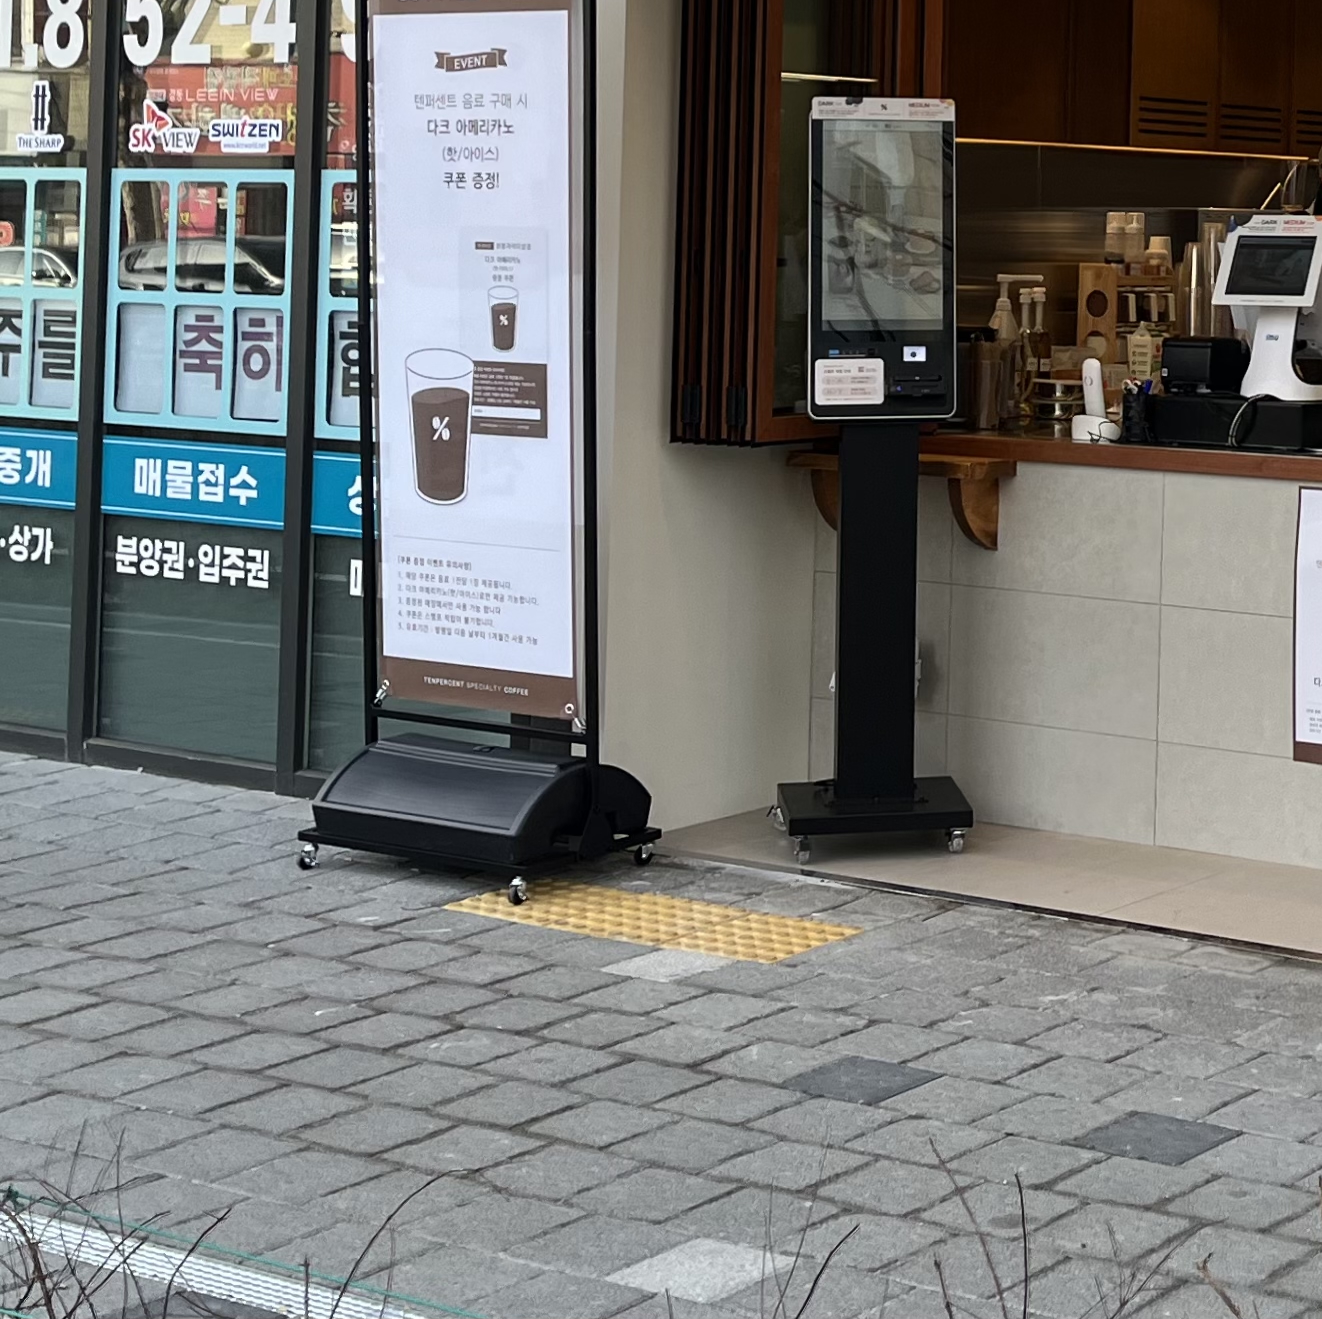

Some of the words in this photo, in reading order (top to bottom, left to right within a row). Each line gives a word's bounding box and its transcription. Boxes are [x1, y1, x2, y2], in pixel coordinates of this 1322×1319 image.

[453, 54, 488, 70] EVENT
[414, 93, 457, 110] 텐퍼센트
[461, 93, 485, 110] 음료
[489, 92, 512, 109] 구매
[517, 92, 528, 108] 시
[426, 119, 450, 136] 다크
[456, 118, 515, 136] 아메리카노
[131, 127, 151, 149] SK
[162, 131, 200, 150] VIEW
[443, 172, 467, 190] 쿠폰
[133, 456, 259, 506] 매물접수
